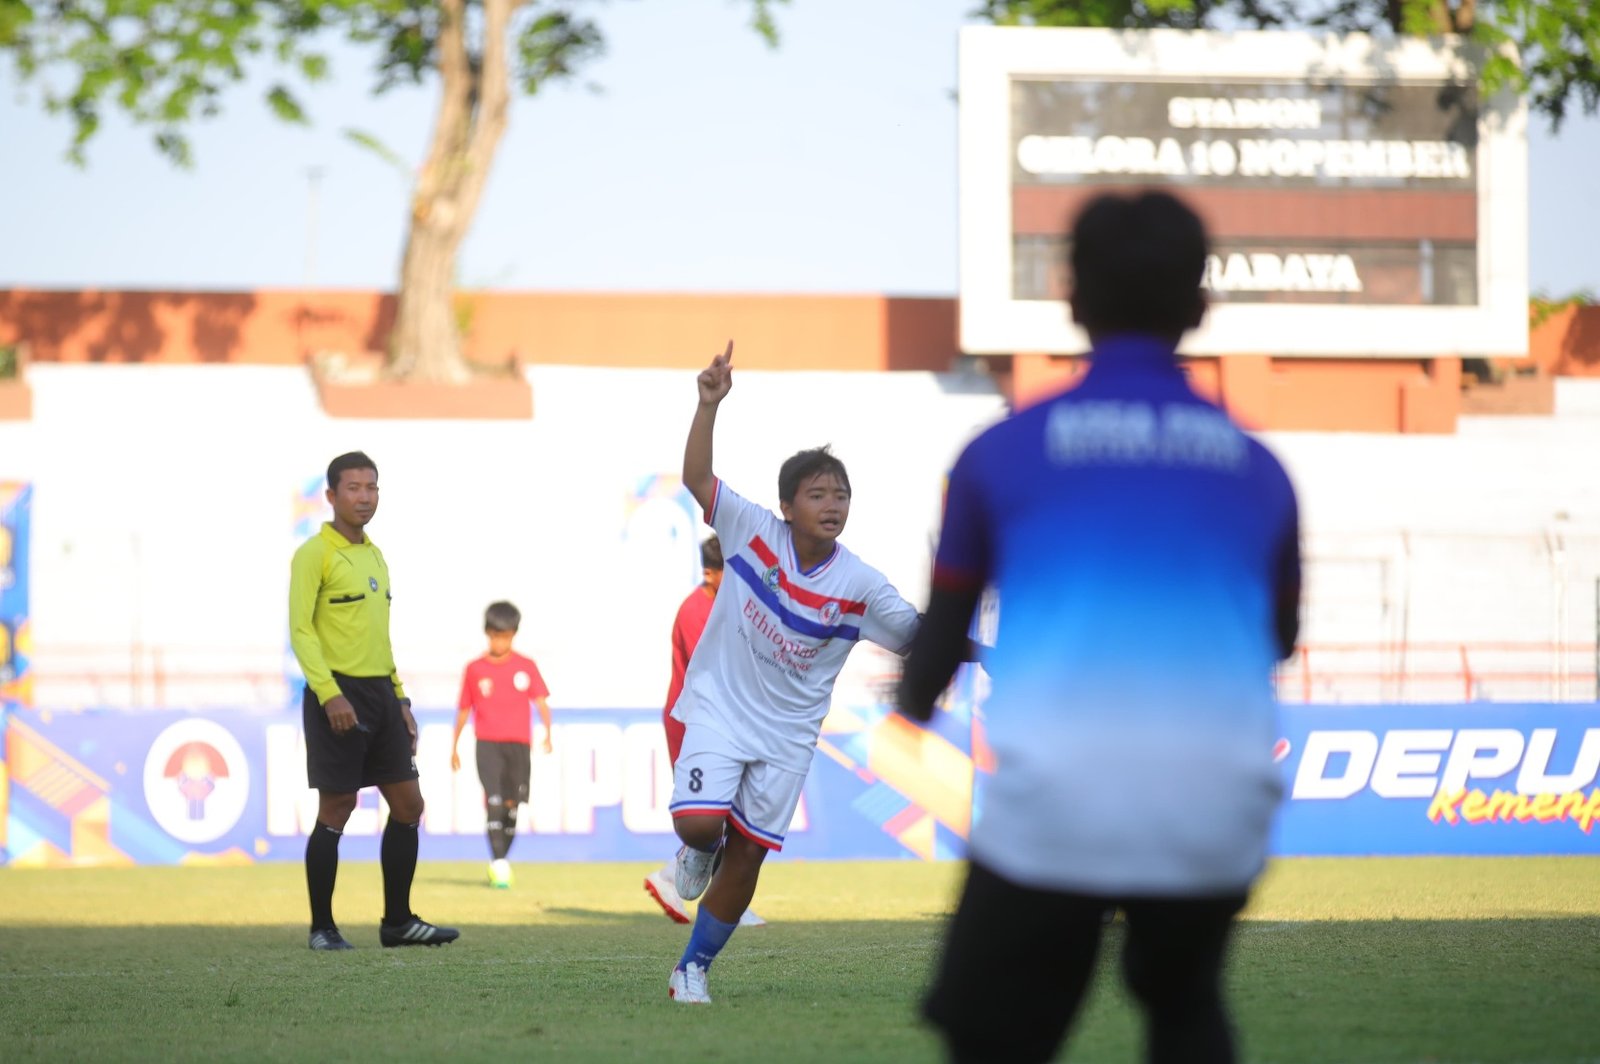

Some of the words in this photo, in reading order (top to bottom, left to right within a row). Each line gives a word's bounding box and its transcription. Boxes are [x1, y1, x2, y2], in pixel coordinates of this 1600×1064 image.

[1168, 97, 1321, 128] STADION
[1018, 135, 1186, 175] GELORA
[1189, 141, 1237, 176] 10
[1239, 139, 1469, 178] NOPEMBER
[743, 598, 818, 659] Ethiopian
[689, 768, 703, 793] 8
